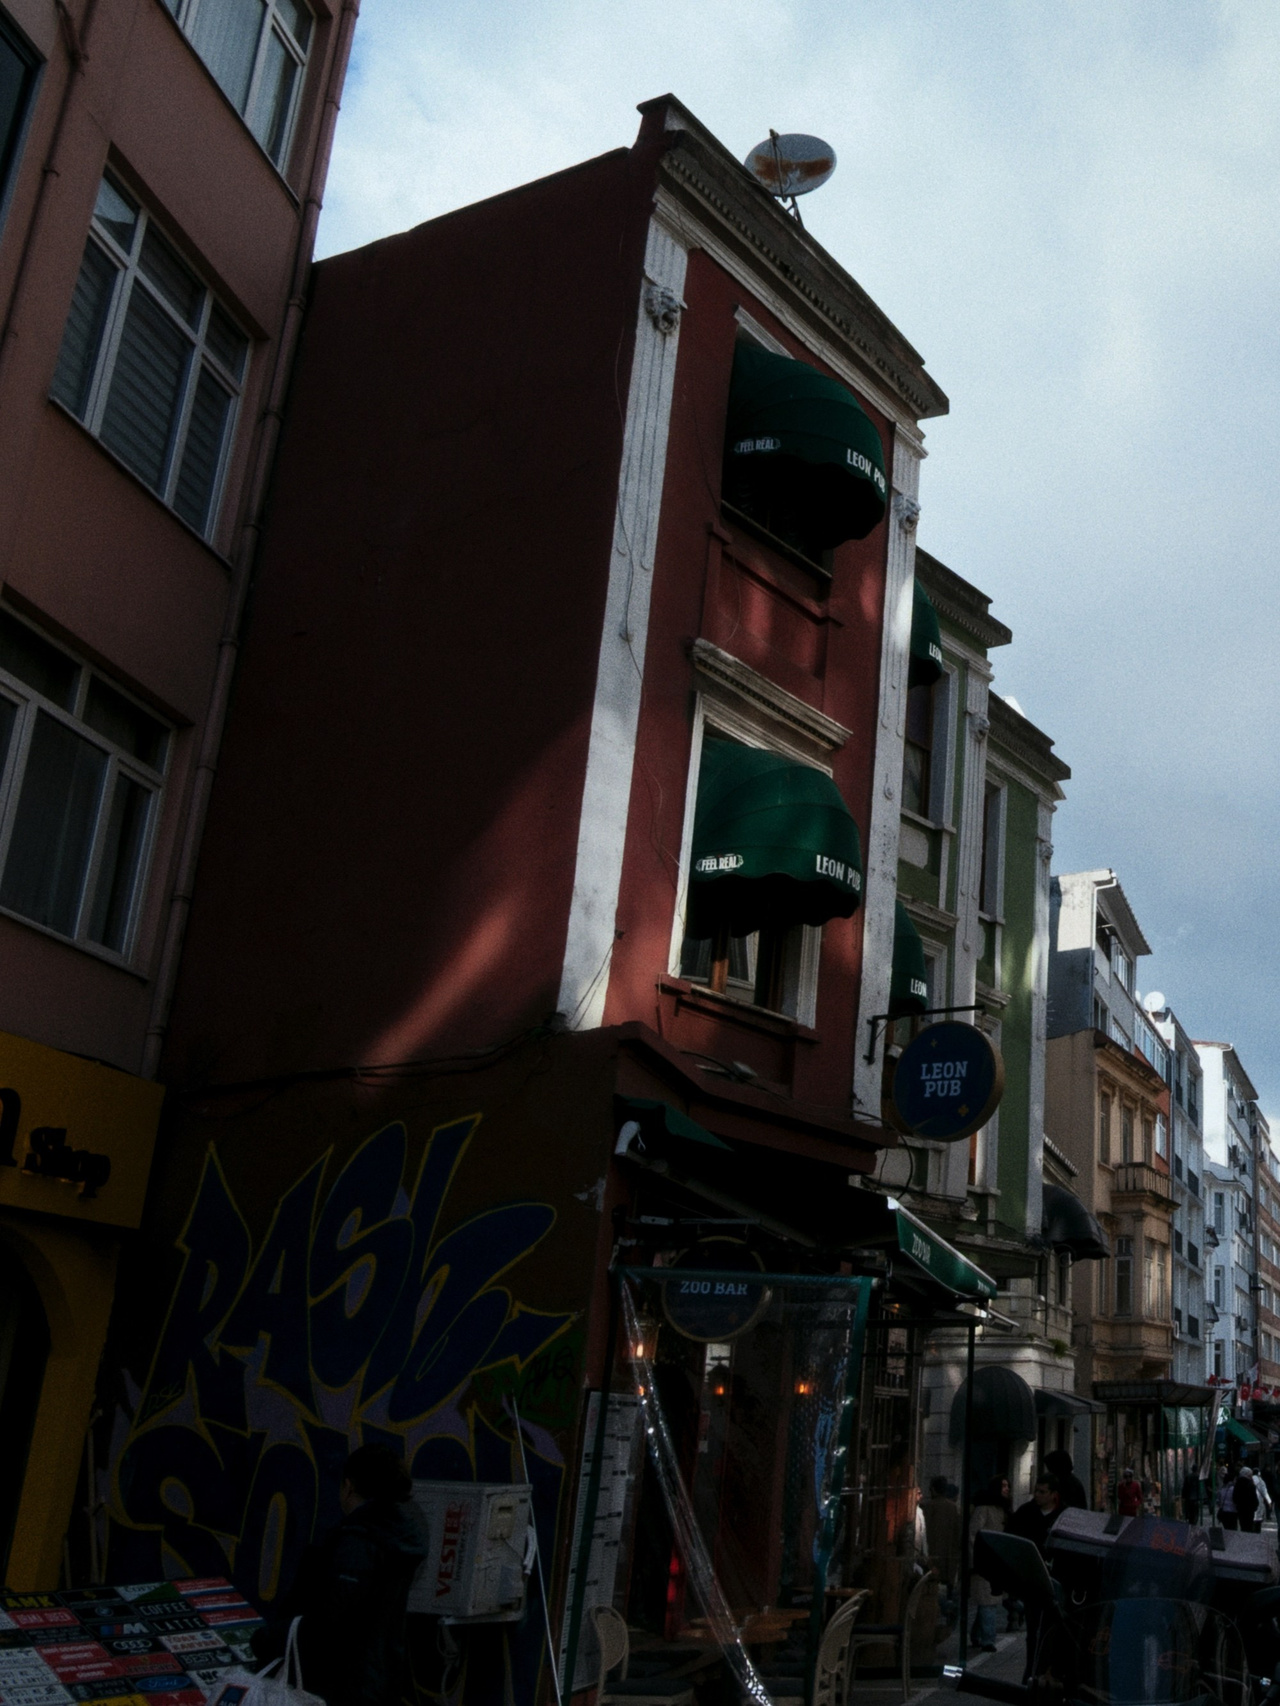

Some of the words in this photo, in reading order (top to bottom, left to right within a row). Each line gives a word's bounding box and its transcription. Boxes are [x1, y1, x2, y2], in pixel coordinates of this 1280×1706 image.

[846, 448, 873, 477] LEON
[701, 859, 718, 871] FEEL
[718, 856, 737, 870] REAL
[815, 854, 845, 882] LEON
[910, 977, 928, 998] LEON
[920, 1060, 969, 1081] LEON
[923, 1079, 963, 1098] PUB
[679, 1280, 712, 1295] ZOO
[714, 1281, 749, 1296] BAR
[139, 1600, 191, 1616] COFFEE
[152, 1616, 206, 1632] LATTE
[180, 1652, 216, 1665] BEST
